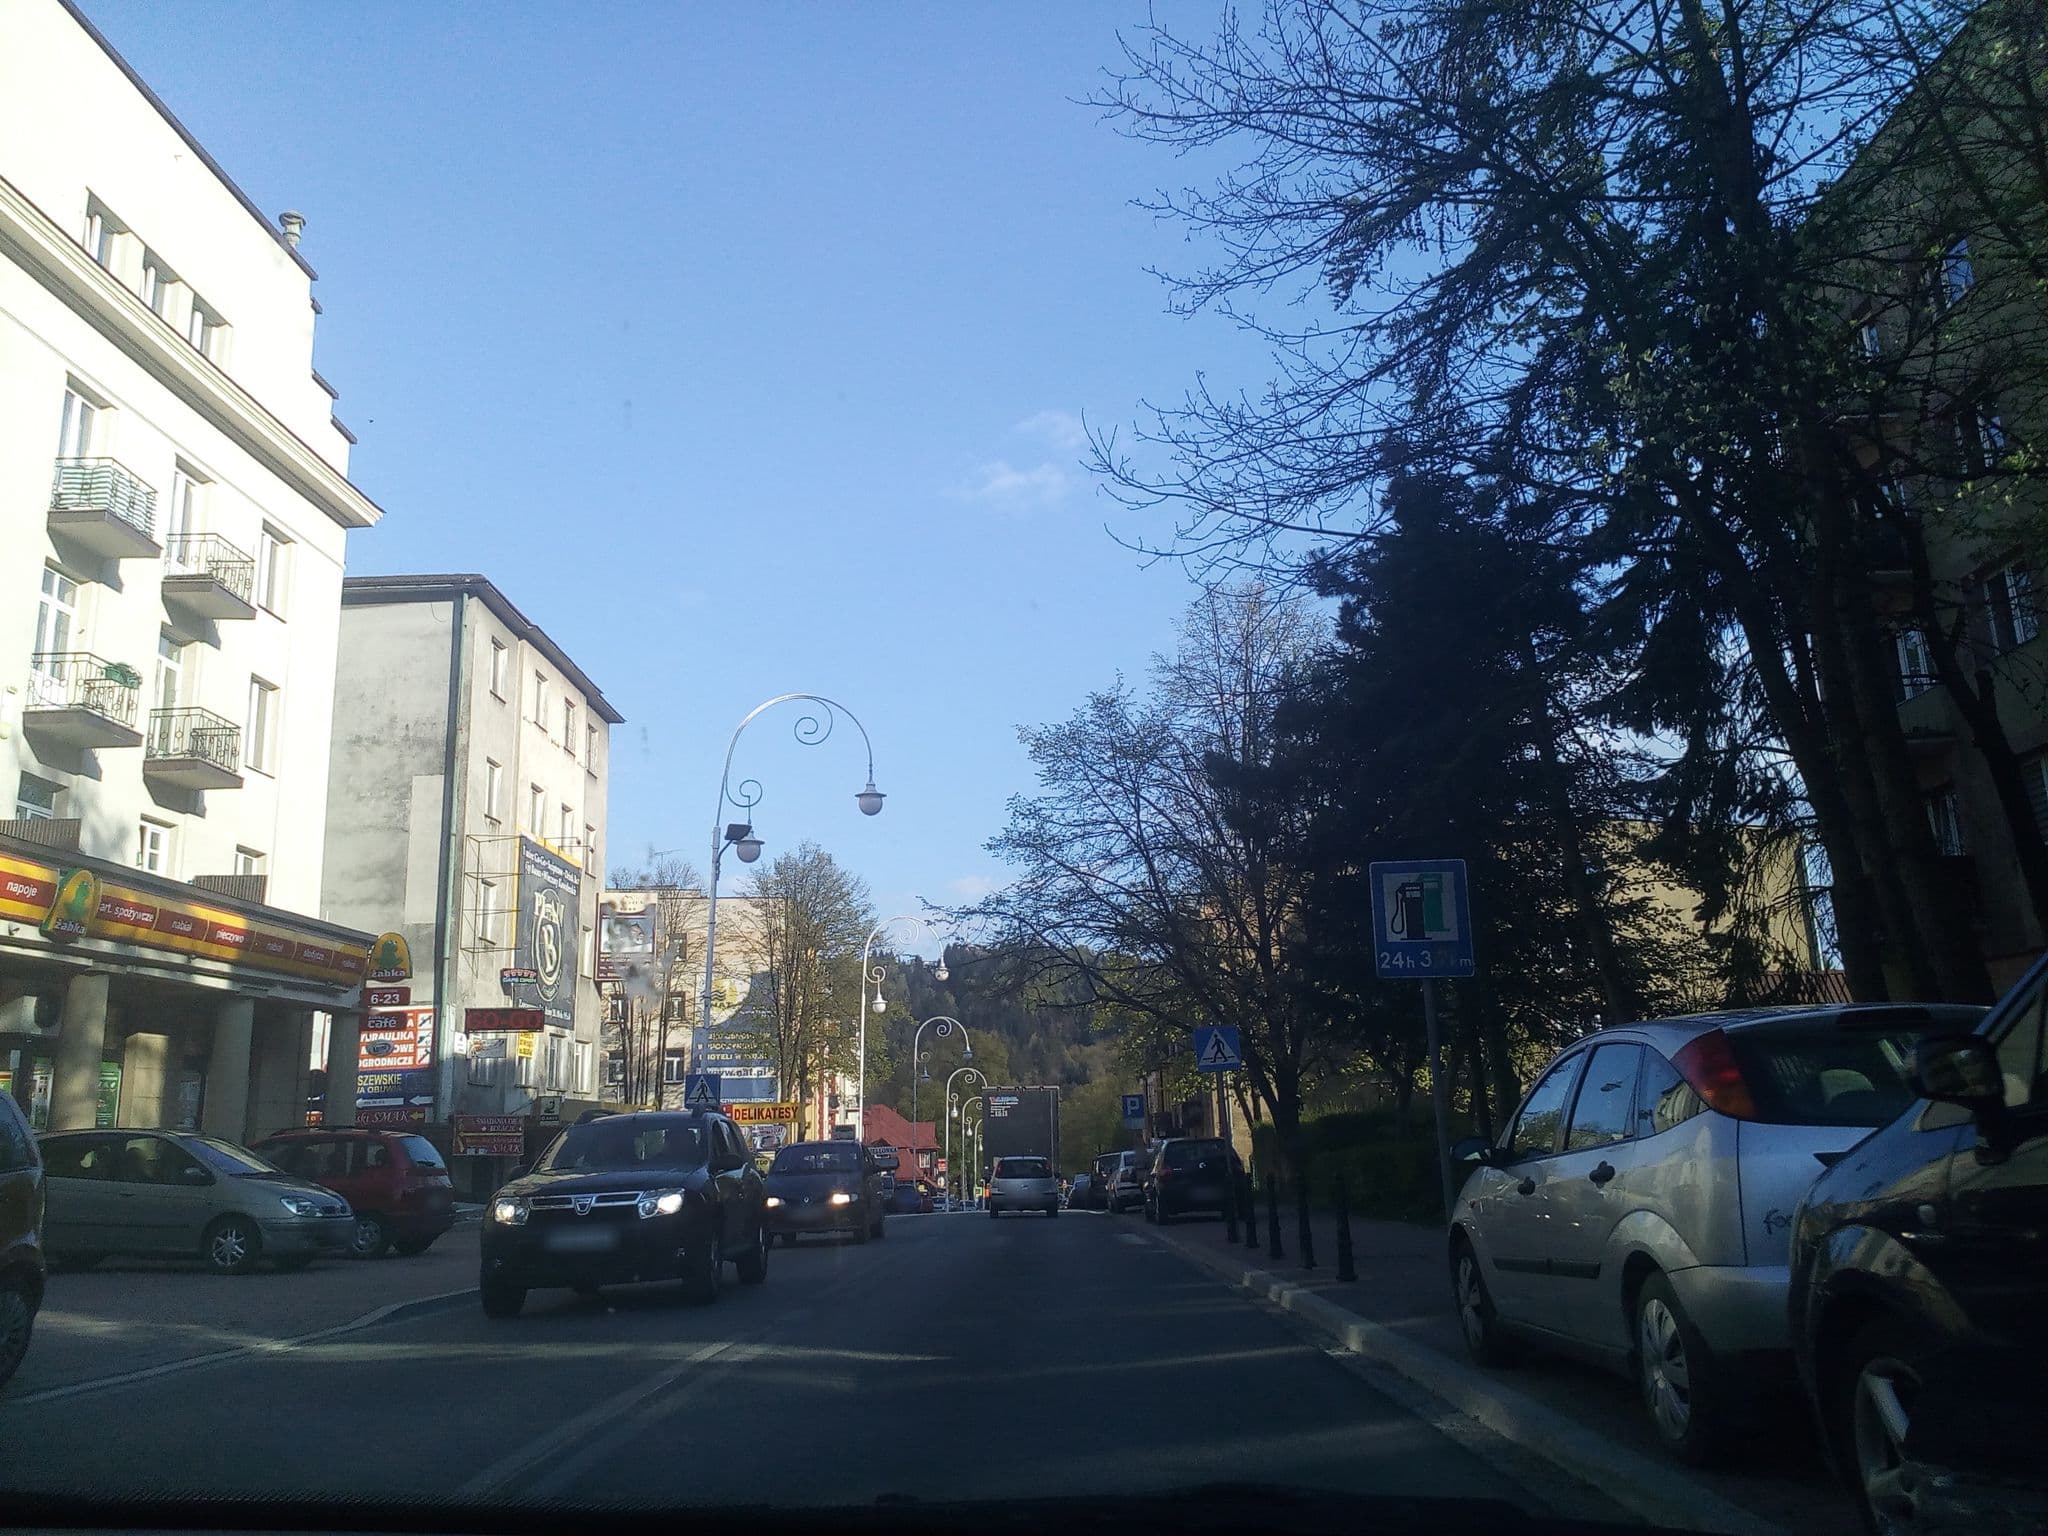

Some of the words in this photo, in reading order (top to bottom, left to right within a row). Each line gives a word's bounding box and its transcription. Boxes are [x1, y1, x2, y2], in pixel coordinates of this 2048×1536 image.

[6, 880, 38, 899] napoje
[99, 901, 113, 914] art.
[114, 906, 155, 923] spożywcze
[55, 918, 86, 935] żabka
[216, 928, 245, 943] pieczywo
[371, 968, 406, 978] żabka
[370, 993, 400, 1005] 6-23
[734, 1106, 799, 1121] DELIKATESY
